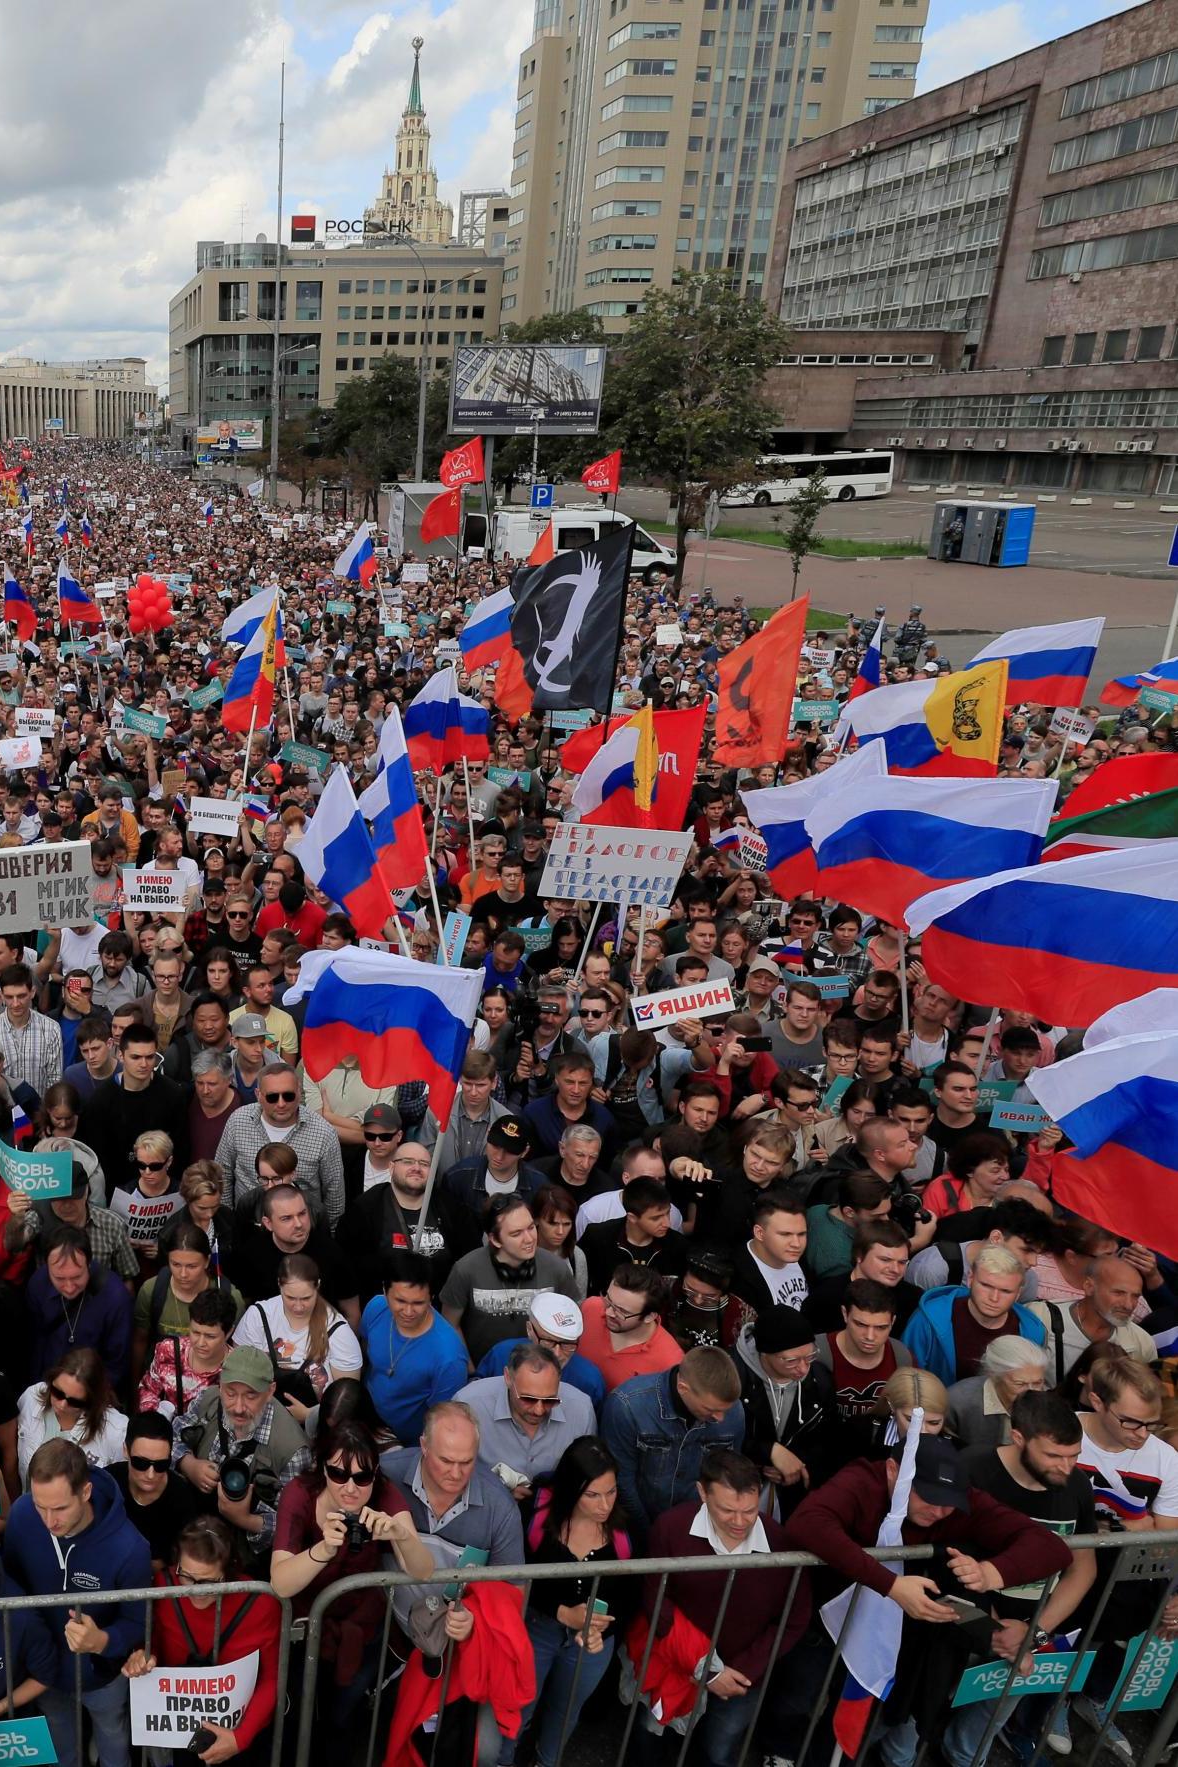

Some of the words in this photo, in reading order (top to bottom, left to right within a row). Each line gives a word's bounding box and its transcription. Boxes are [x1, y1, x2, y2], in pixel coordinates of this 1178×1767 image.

[537, 487, 548, 503] P
[18, 718, 51, 727] ВЫБИРАЕМ
[25, 711, 43, 719] ЗДЕСЬ
[128, 713, 159, 727] ЛЮБОВЬ
[131, 720, 160, 734] СОБОЛЬ
[555, 825, 597, 840] НЕТ
[568, 841, 686, 862] НАЛОГОВ
[742, 836, 749, 844] Я
[749, 839, 768, 854] ИМЕ
[549, 854, 591, 869] БЕЗ
[37, 876, 89, 899] МГИК
[136, 876, 143, 884] Я
[144, 876, 172, 885] ИМЕЮ
[140, 885, 169, 894] ПРАВО
[130, 895, 144, 903] НА
[144, 895, 179, 904] ВЫБОР!
[38, 899, 90, 923] ЦИК
[453, 919, 462, 941] ИВАН
[658, 987, 731, 1016] ЯШИН
[1000, 1112, 1034, 1122] ИВАН
[128, 1204, 138, 1215] Я
[139, 1202, 174, 1216] ИМЕЮ
[129, 1216, 167, 1229] ПРАВО
[131, 1230, 161, 1240] ВЫБ
[1142, 1640, 1171, 1697] ЮБОВЬ
[158, 1678, 171, 1693] Я
[175, 1675, 236, 1695] ИМЕЮ
[166, 1696, 230, 1713] ПРАВО
[146, 1715, 172, 1732] НА
